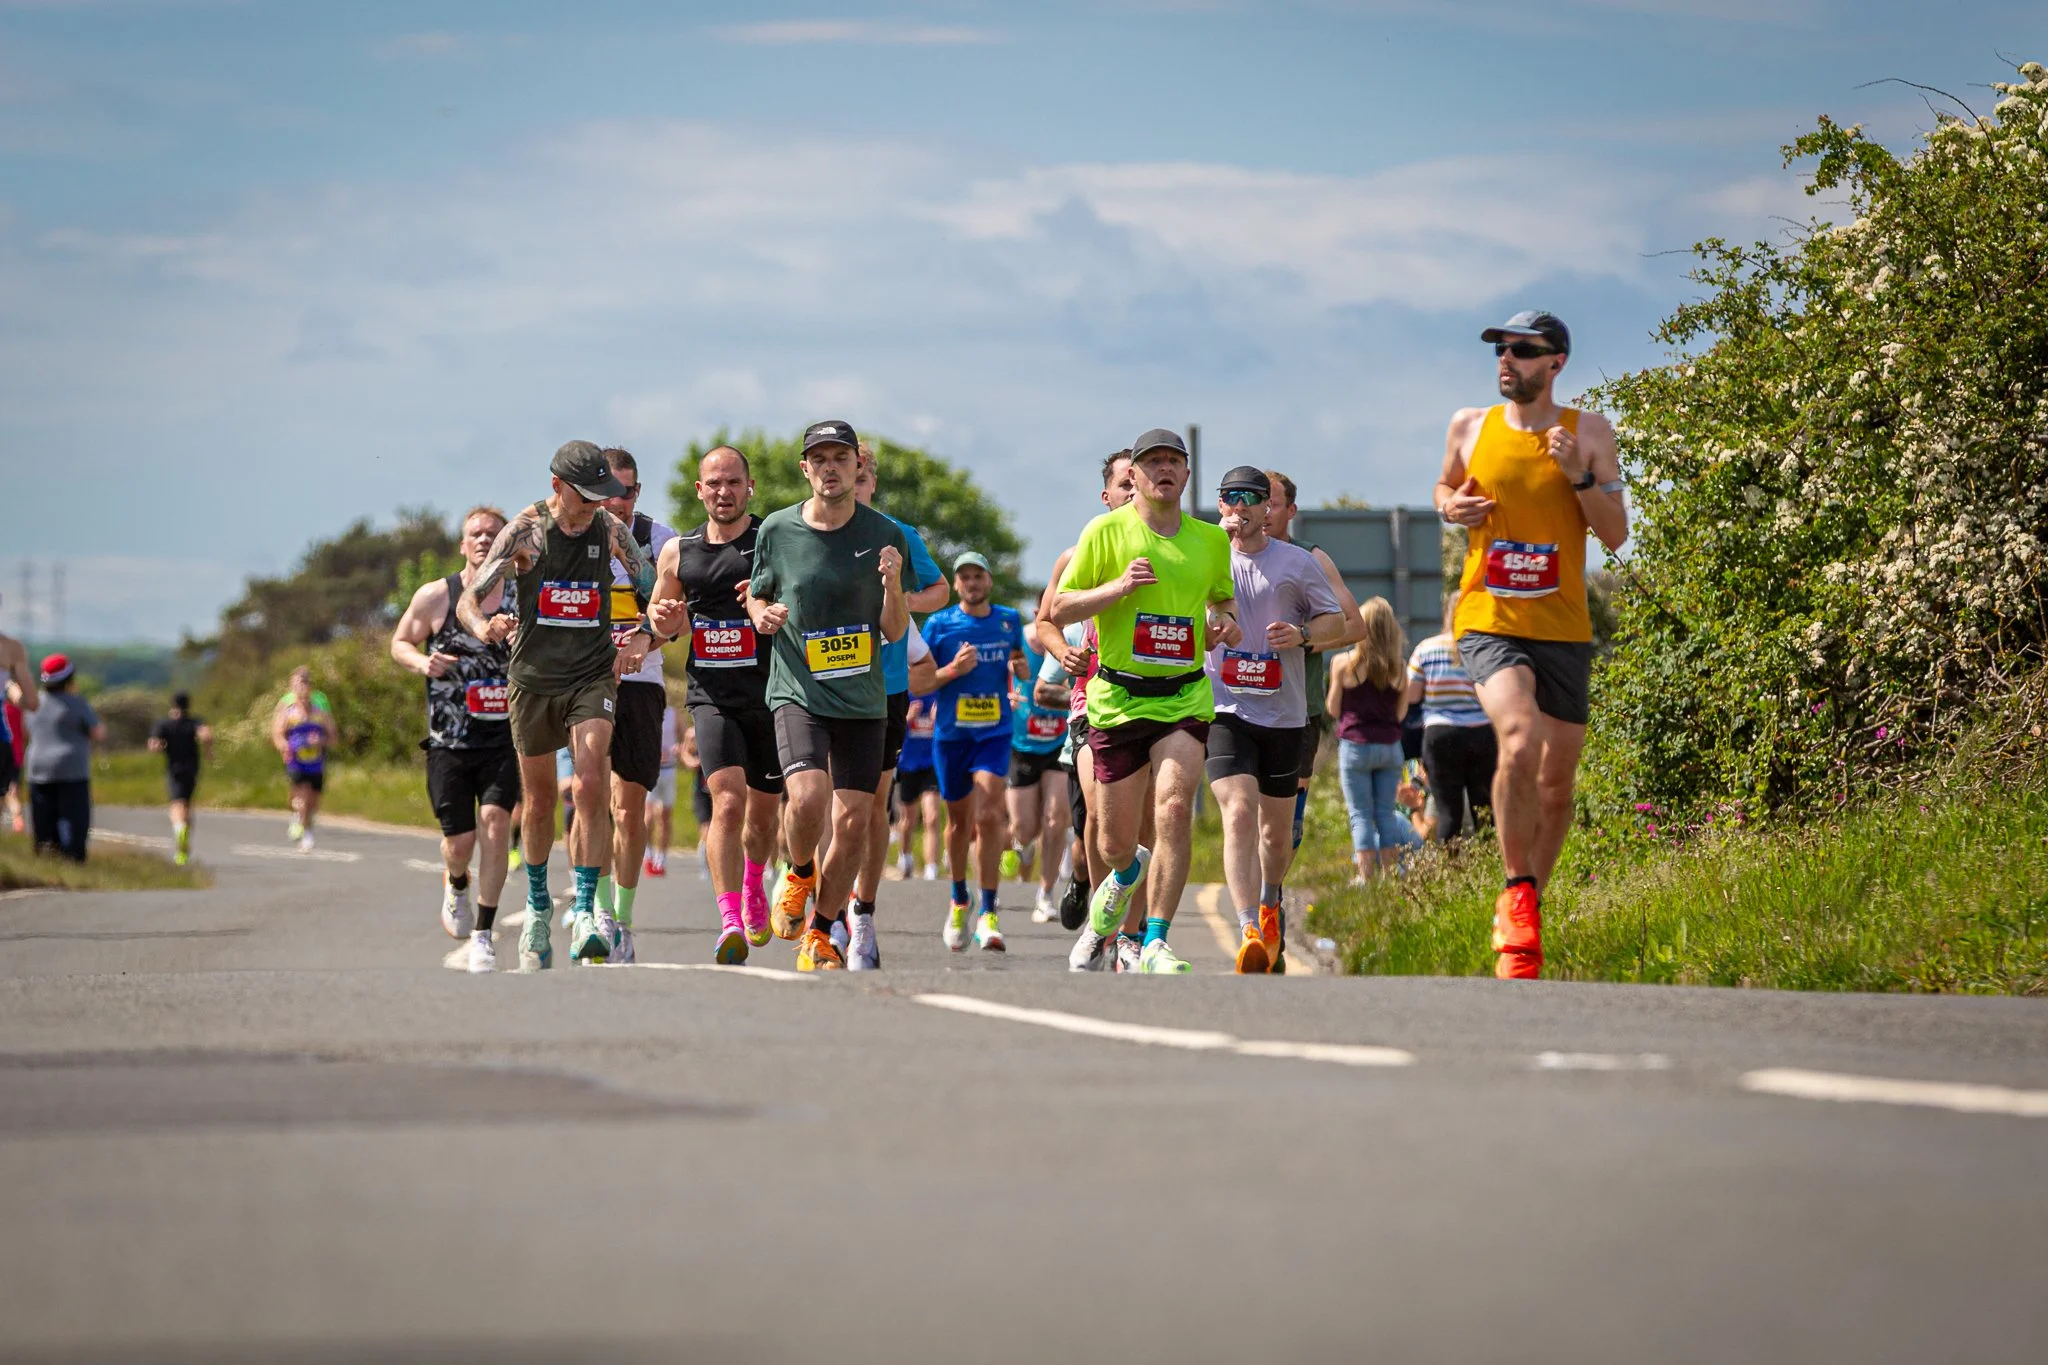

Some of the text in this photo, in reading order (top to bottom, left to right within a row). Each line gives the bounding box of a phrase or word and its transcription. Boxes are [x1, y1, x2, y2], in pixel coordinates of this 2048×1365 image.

[1503, 552, 1549, 571] 1542
[551, 590, 590, 604] 2205
[611, 632, 631, 644] 72
[704, 630, 741, 643] 1929
[1149, 625, 1188, 641] 1556
[820, 636, 858, 653] 3051
[1155, 642, 1181, 651] DAVID
[827, 653, 856, 663] JOSEPH
[1237, 660, 1266, 673] 929
